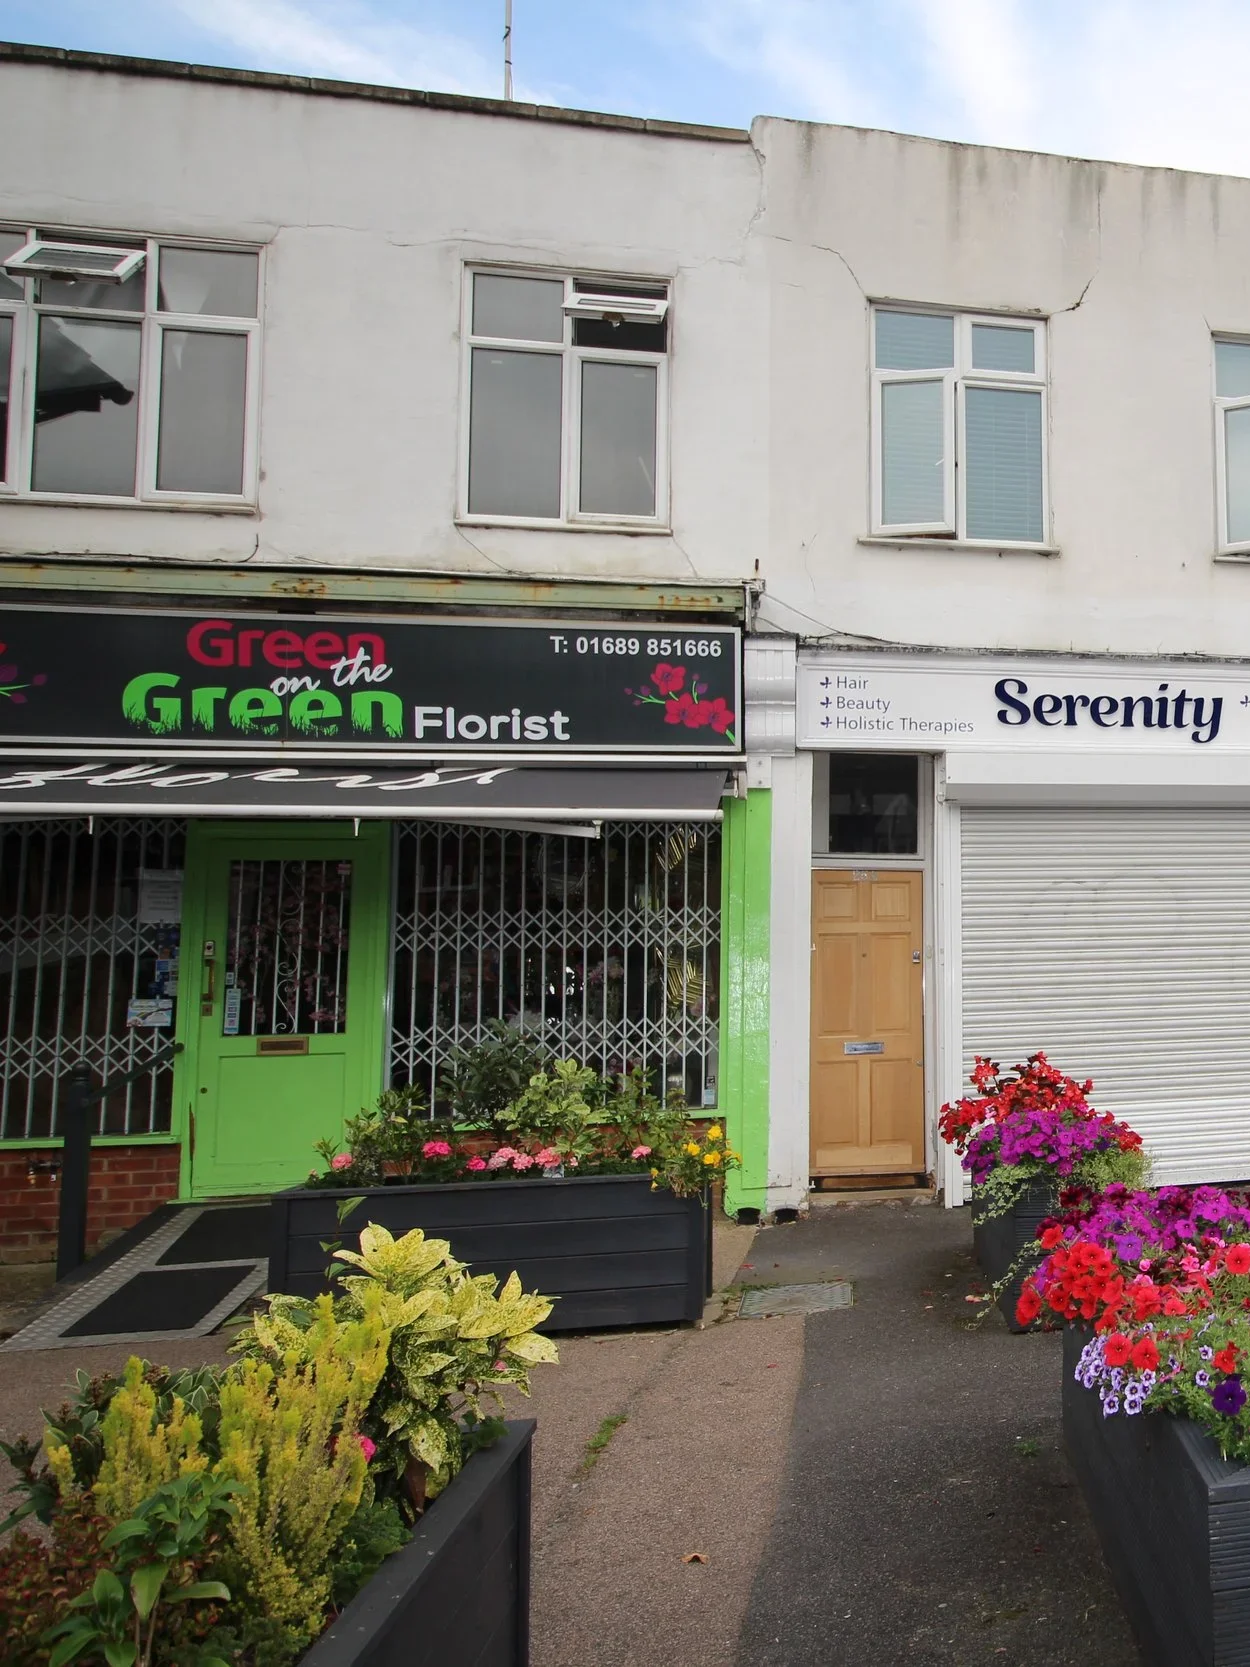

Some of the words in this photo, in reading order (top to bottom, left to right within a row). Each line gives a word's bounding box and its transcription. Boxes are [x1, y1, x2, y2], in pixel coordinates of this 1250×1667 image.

[187, 619, 386, 668] Green
[550, 636, 569, 655] T:
[576, 637, 640, 656] 01689
[647, 639, 722, 658] 851666
[270, 673, 320, 697] on
[331, 647, 393, 688] the
[836, 675, 869, 691] Hair
[122, 672, 403, 738] Green
[836, 694, 891, 713] Beauty
[994, 677, 1223, 744] Serenity
[414, 706, 570, 741] Florist
[836, 714, 895, 731] Holistic
[900, 717, 974, 736] Therapies
